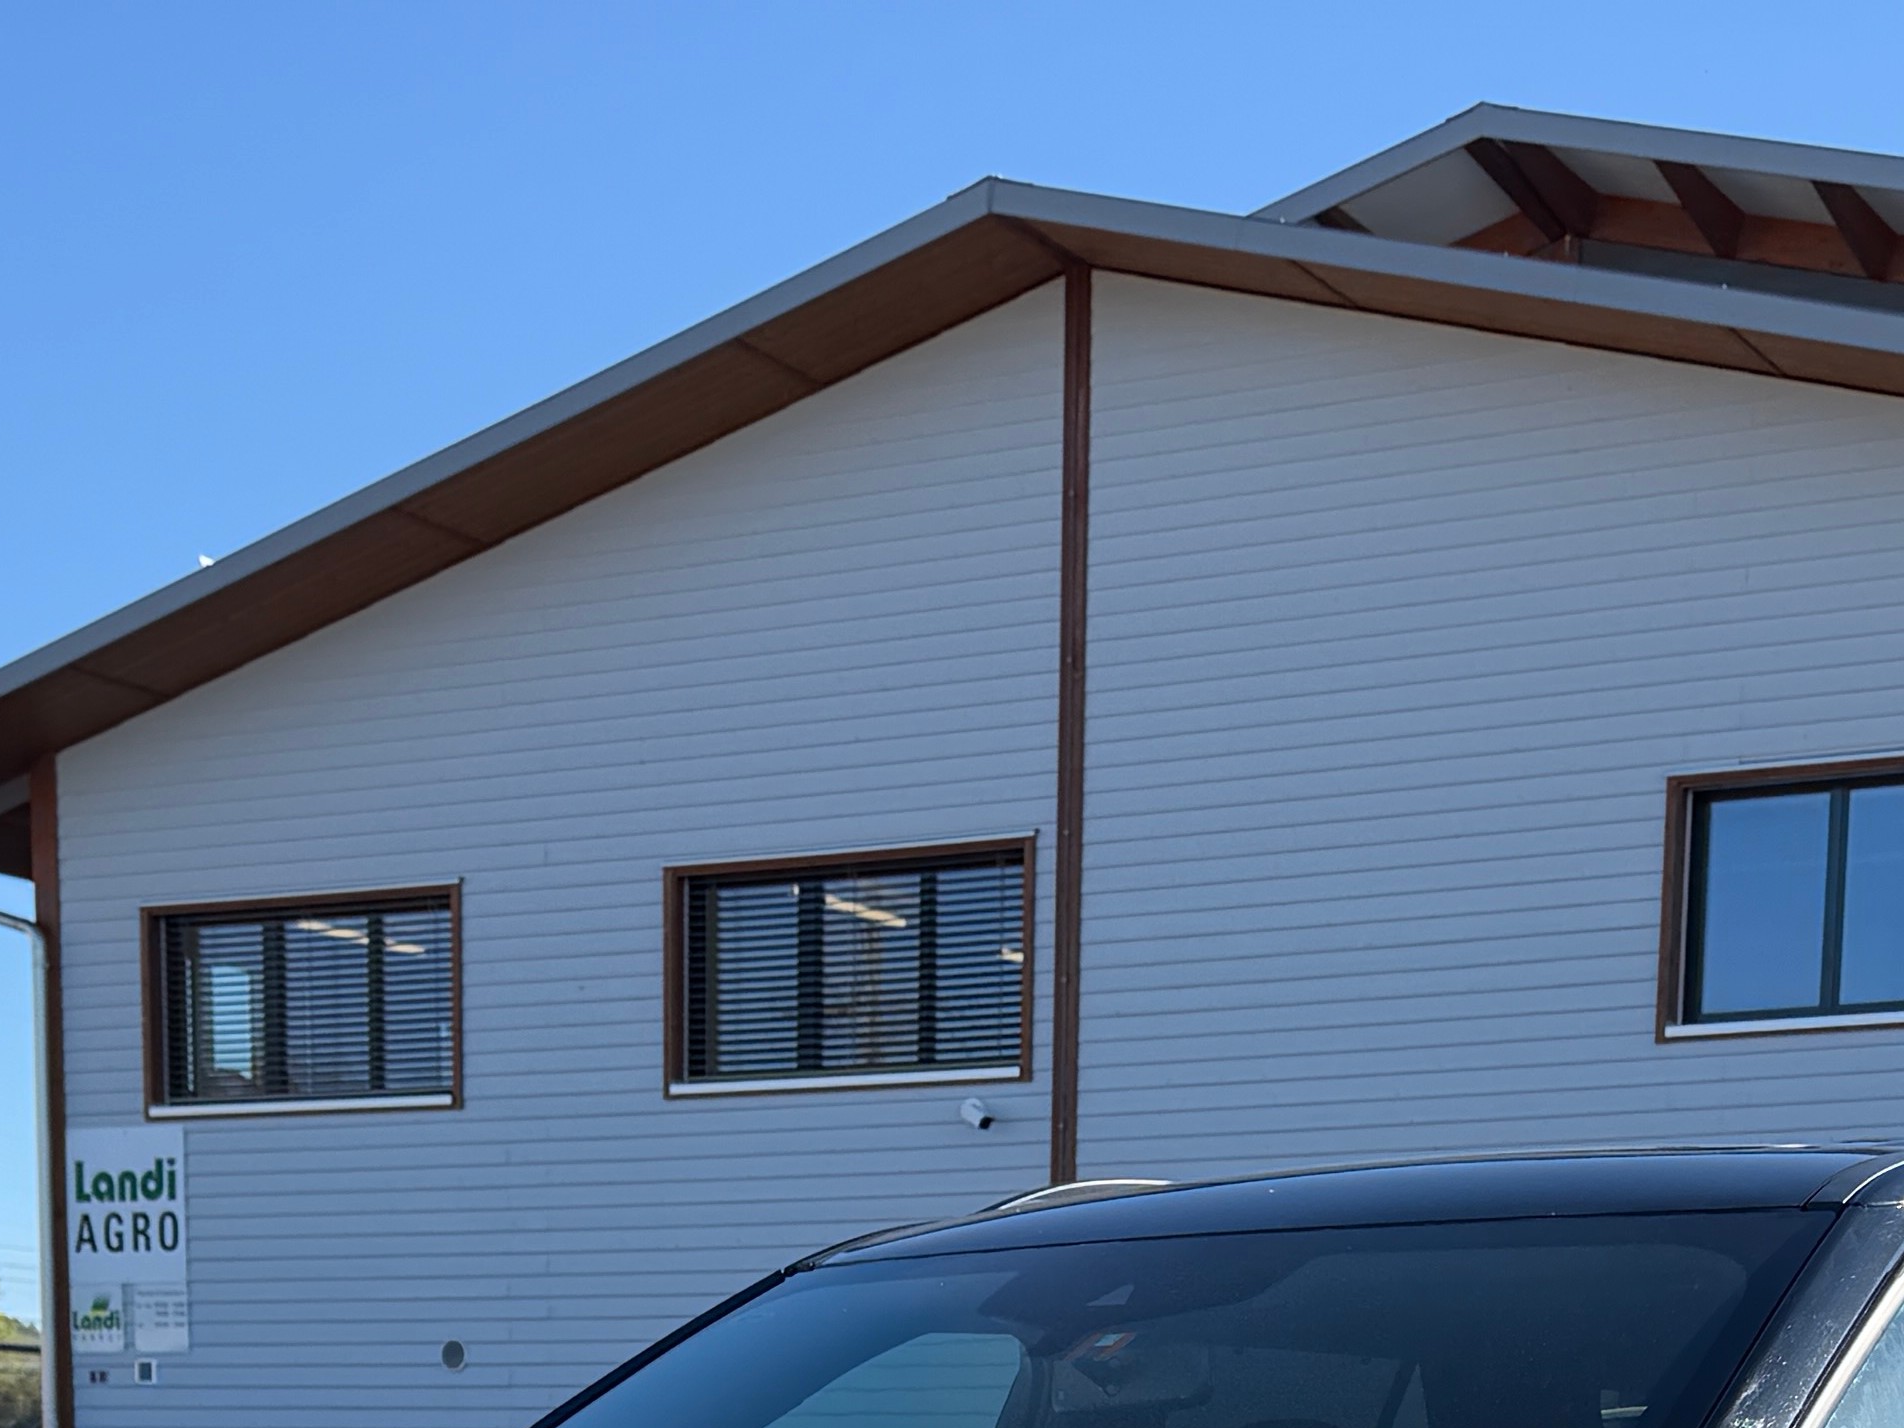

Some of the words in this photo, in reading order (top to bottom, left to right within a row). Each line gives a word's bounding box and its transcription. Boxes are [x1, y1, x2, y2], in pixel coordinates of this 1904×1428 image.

[73, 1157, 177, 1203] Landi
[75, 1211, 179, 1253] AGRO
[72, 1310, 121, 1331] Landi
